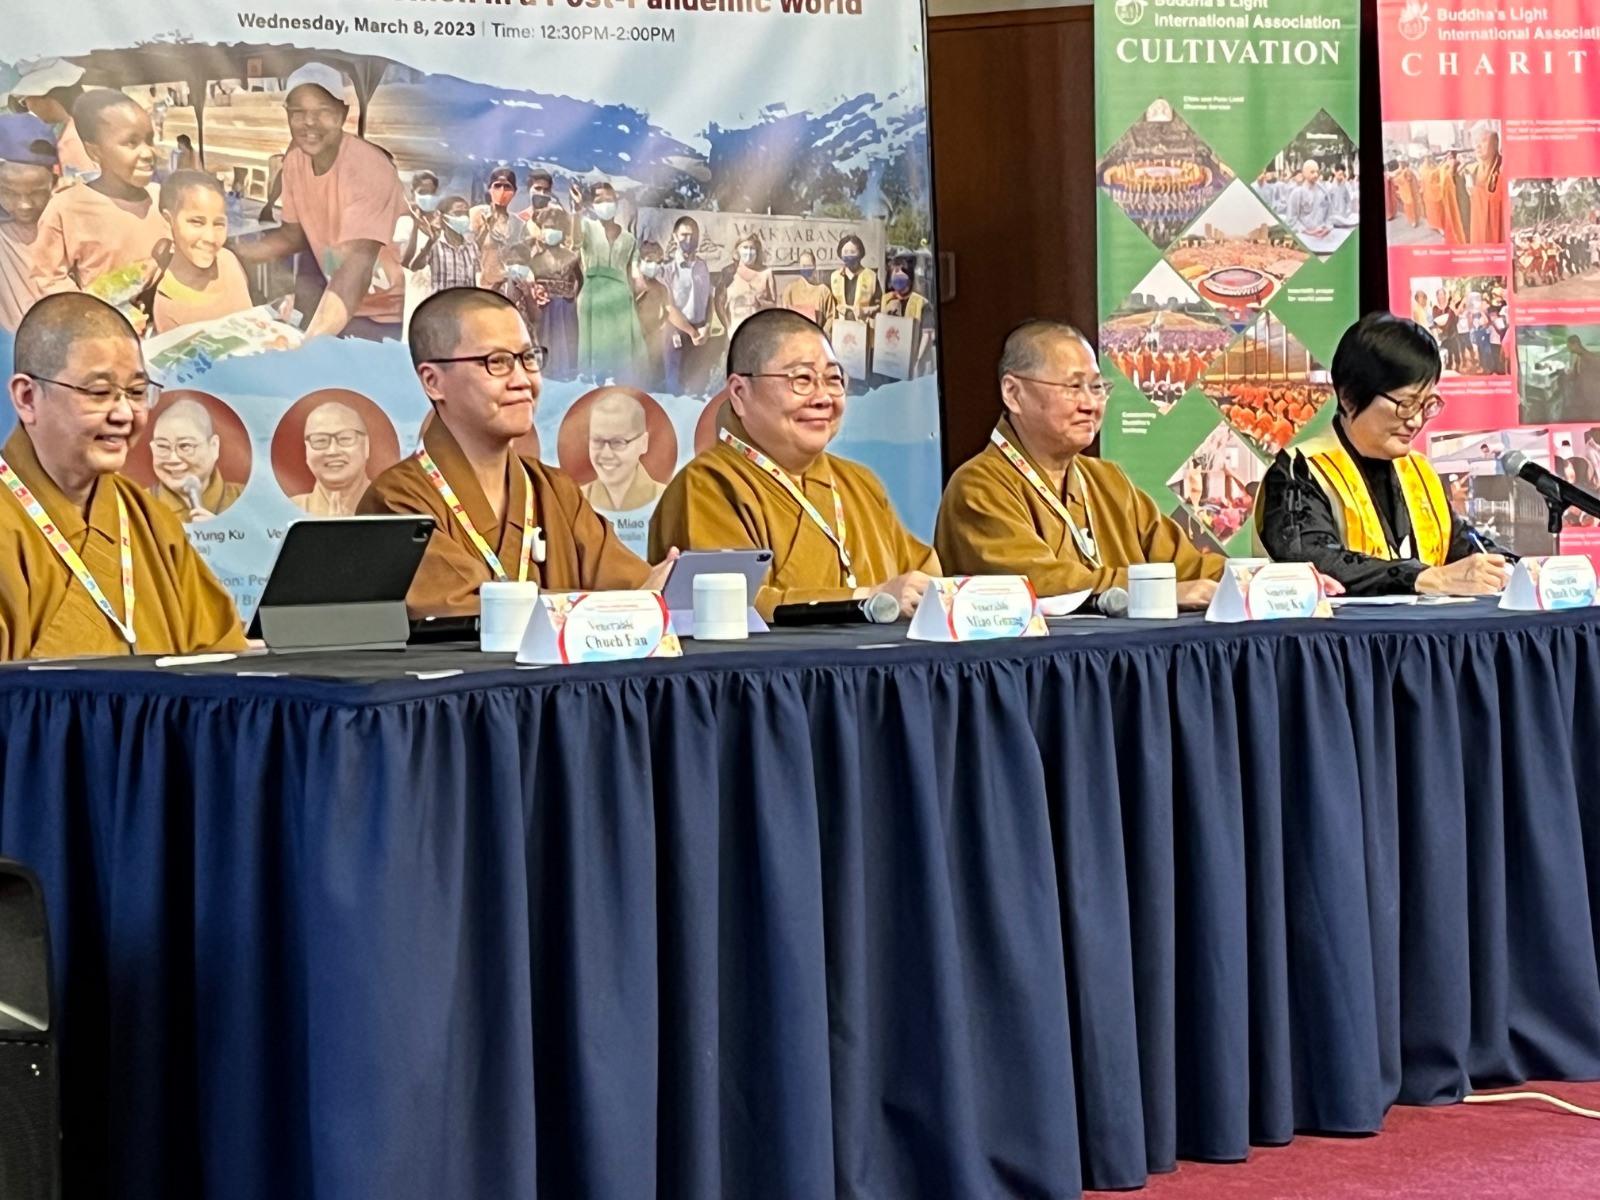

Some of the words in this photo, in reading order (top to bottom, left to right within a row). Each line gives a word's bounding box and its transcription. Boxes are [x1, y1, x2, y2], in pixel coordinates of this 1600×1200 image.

[1154, 13, 1249, 28] International
[1253, 14, 1341, 29] Association
[1437, 8, 1507, 22] Buddha's
[1510, 8, 1548, 24] Light
[237, 13, 349, 35] Wednesday,
[354, 17, 408, 34] March
[413, 20, 430, 37] 8,
[434, 21, 476, 37] 2023
[491, 22, 535, 39] Time:
[540, 25, 676, 43] 12:30PM-2:00PM
[1438, 27, 1530, 41] International
[1116, 37, 1340, 65] CULTIVATION
[1401, 51, 1600, 77] CHARIT
[193, 530, 225, 543] Yung
[229, 529, 245, 540] Ku
